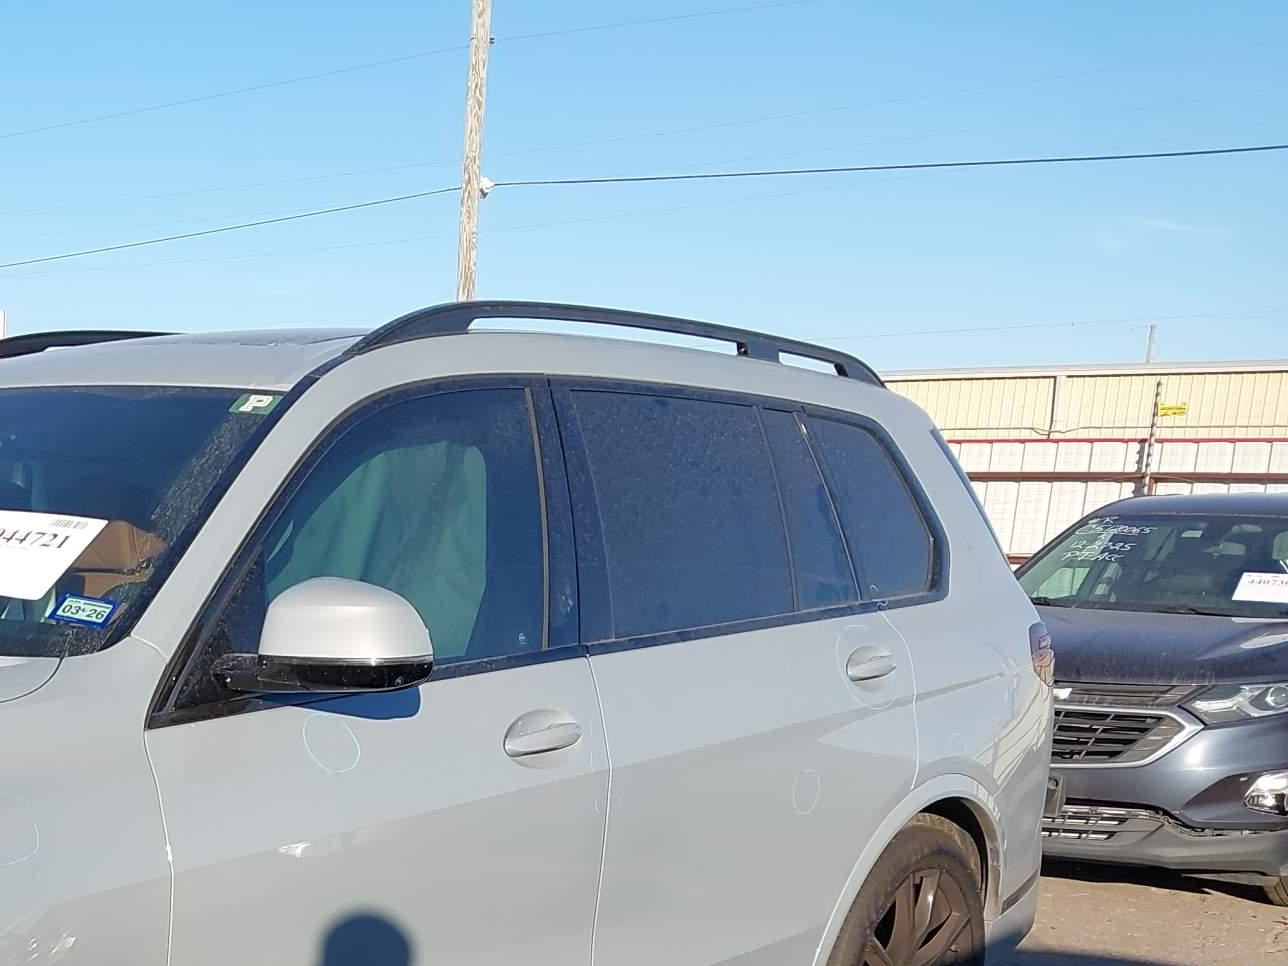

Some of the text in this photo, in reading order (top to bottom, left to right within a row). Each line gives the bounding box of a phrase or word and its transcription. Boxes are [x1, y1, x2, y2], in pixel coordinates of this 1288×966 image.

[238, 394, 274, 412] P
[62, 604, 81, 615] 03
[86, 608, 107, 620] 26
